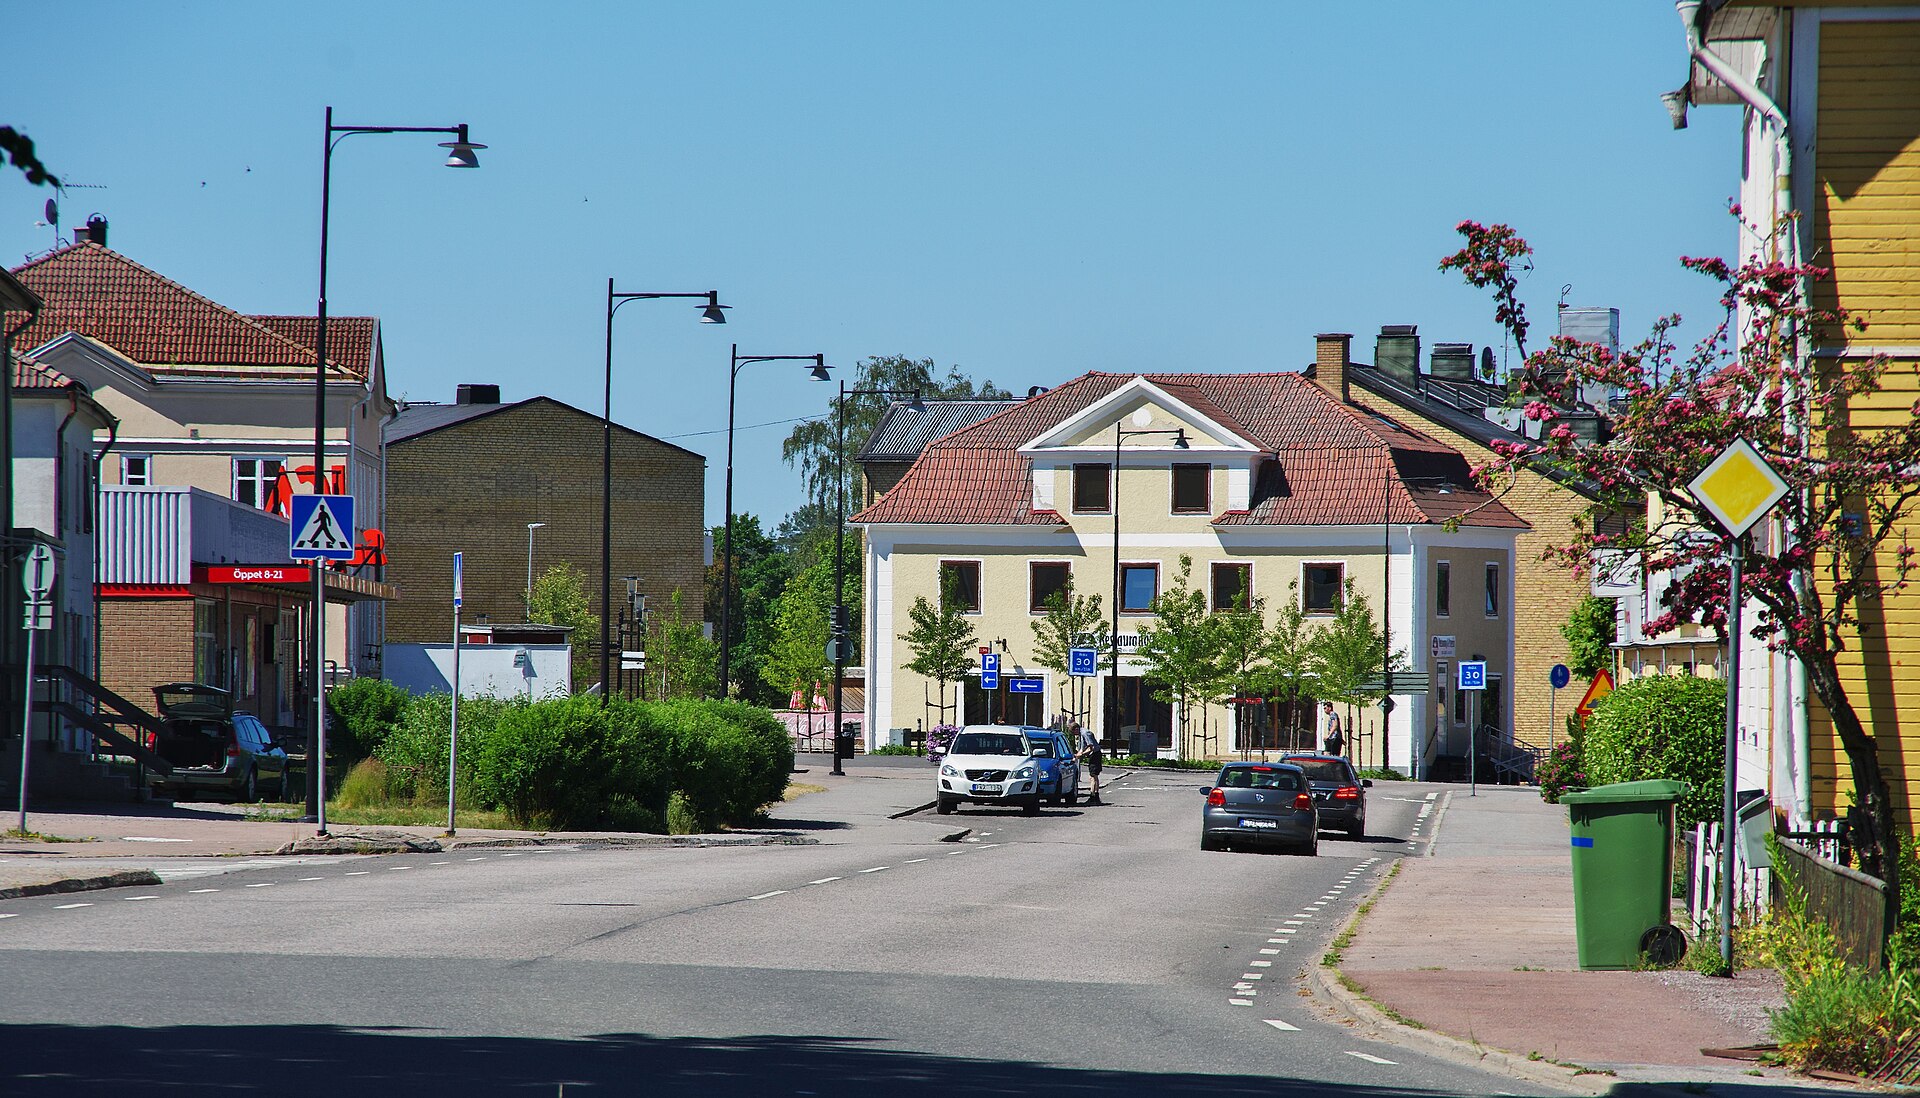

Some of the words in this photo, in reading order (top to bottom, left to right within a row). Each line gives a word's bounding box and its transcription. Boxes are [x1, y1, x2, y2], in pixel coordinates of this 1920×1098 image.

[233, 568, 262, 580] Öppet
[264, 570, 283, 579] 8-21
[985, 656, 995, 670] P
[1076, 658, 1091, 666] 30
[1465, 671, 1480, 679] 30
